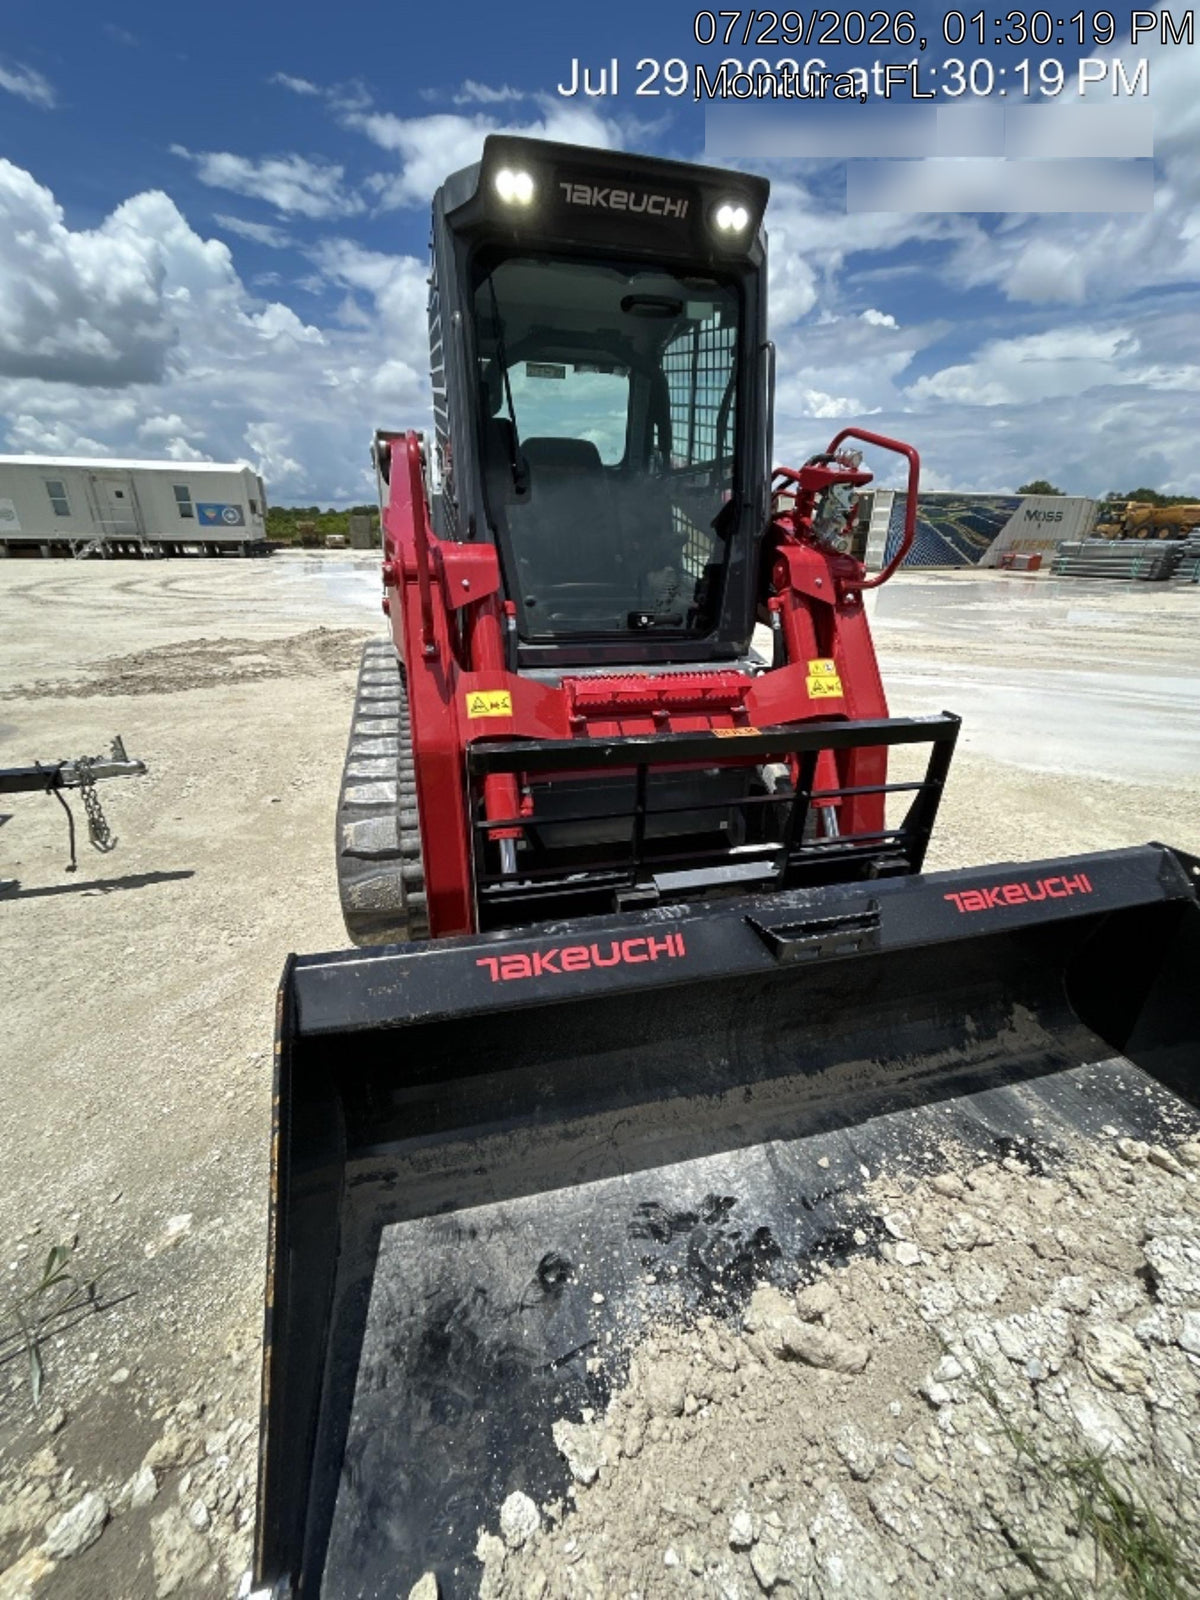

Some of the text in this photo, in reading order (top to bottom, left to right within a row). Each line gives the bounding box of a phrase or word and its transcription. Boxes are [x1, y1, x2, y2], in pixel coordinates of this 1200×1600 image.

[559, 182, 689, 219] TAKEUCHI
[943, 873, 1093, 913] TAKEUCHI
[475, 932, 686, 982] TAKEUCHI
